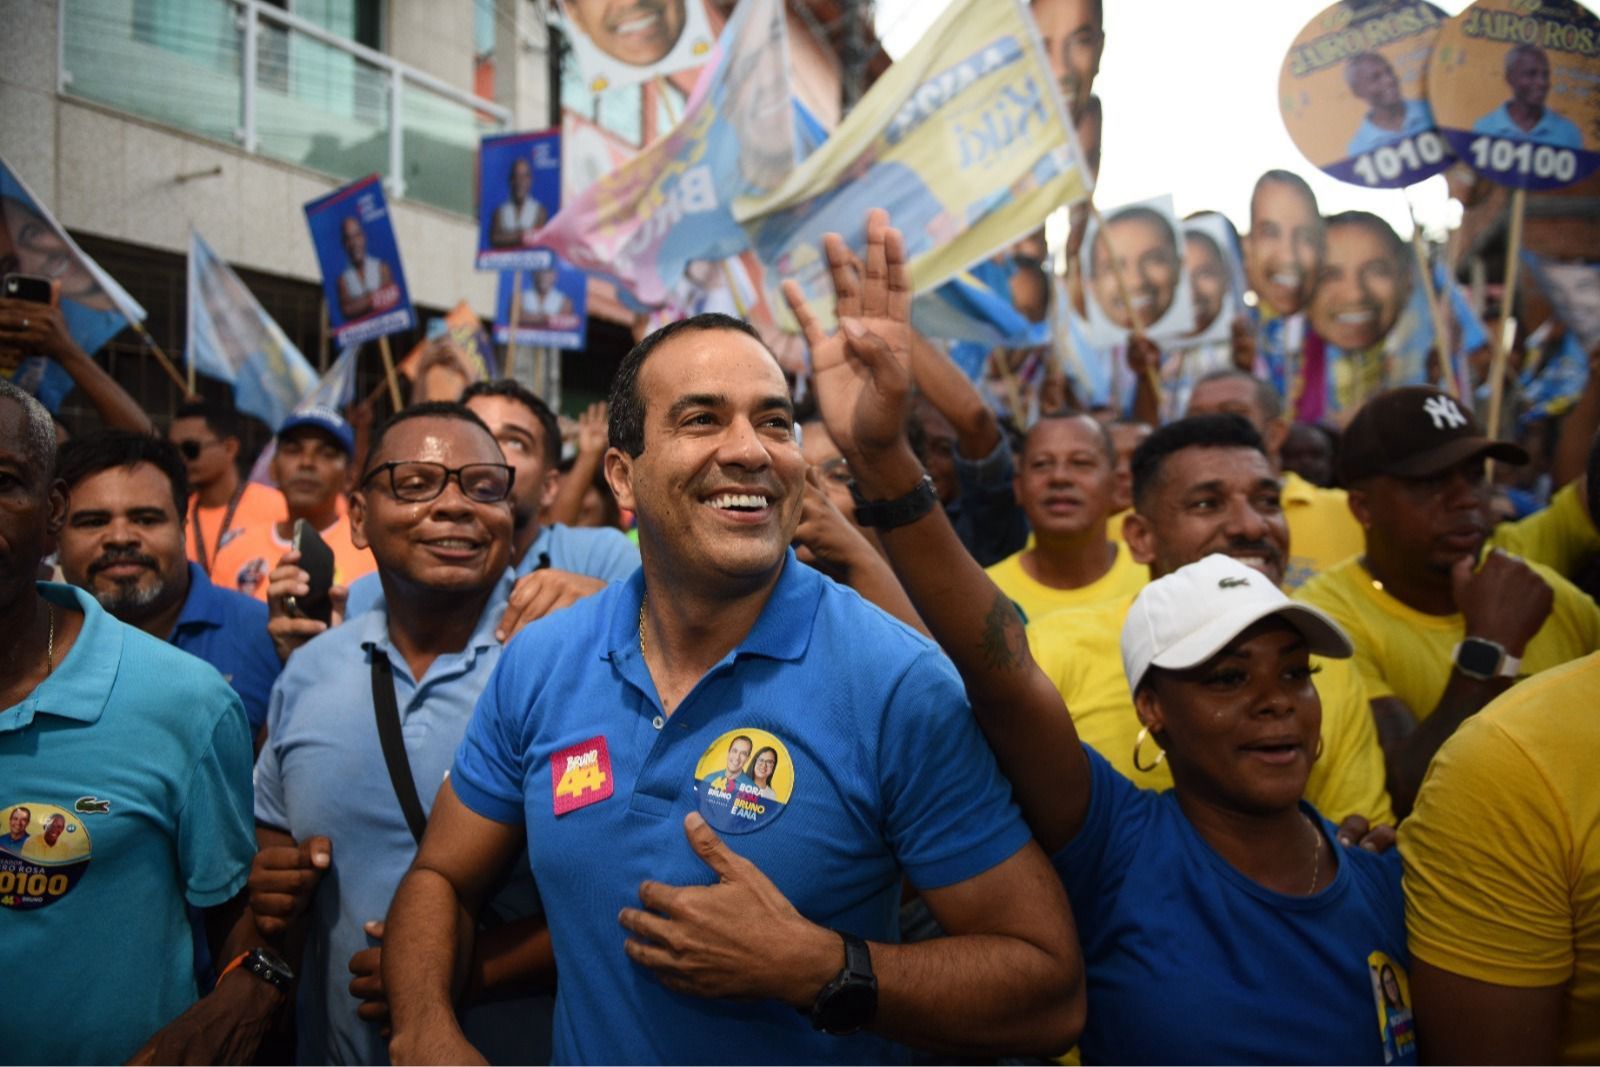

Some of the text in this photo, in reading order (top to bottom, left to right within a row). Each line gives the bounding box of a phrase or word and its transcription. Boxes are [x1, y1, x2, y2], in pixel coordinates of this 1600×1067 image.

[1463, 8, 1539, 44] JAIRO
[1470, 136, 1578, 182] 10100
[567, 749, 598, 771] BRUNO
[556, 761, 607, 798] 44
[739, 783, 764, 797] BORA
[708, 788, 732, 799] BRUNO
[731, 805, 757, 820] E ANA
[733, 798, 765, 814] BRUNO
[0, 871, 68, 896] 0100
